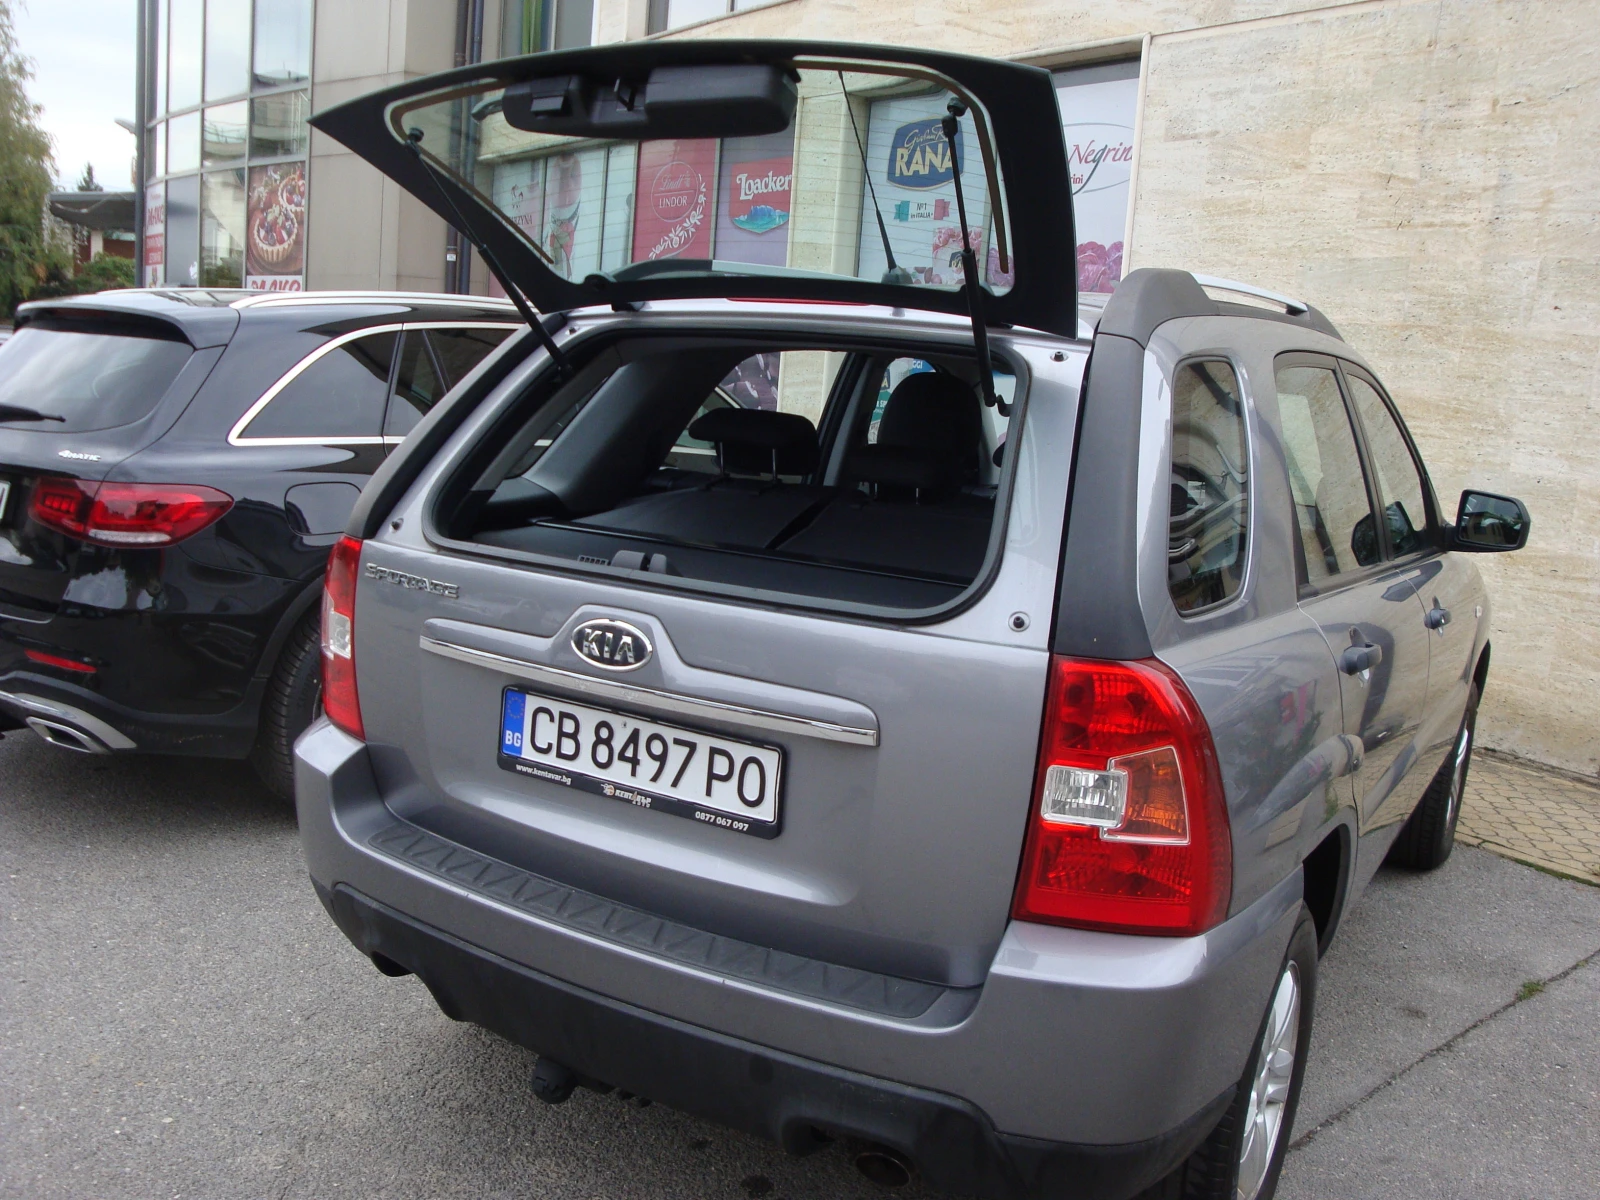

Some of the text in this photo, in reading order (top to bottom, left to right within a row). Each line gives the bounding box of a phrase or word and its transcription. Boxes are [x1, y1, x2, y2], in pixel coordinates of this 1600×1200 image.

[736, 170, 792, 200] Loacker
[659, 196, 688, 208] LINDOR
[364, 562, 460, 599] SPORTAGE
[582, 627, 636, 664] KIA
[505, 729, 522, 748] BG
[529, 706, 767, 808] CB 8497 PO
[515, 763, 572, 786] www.kentavar.bg
[695, 811, 749, 832] 0877 067 097
